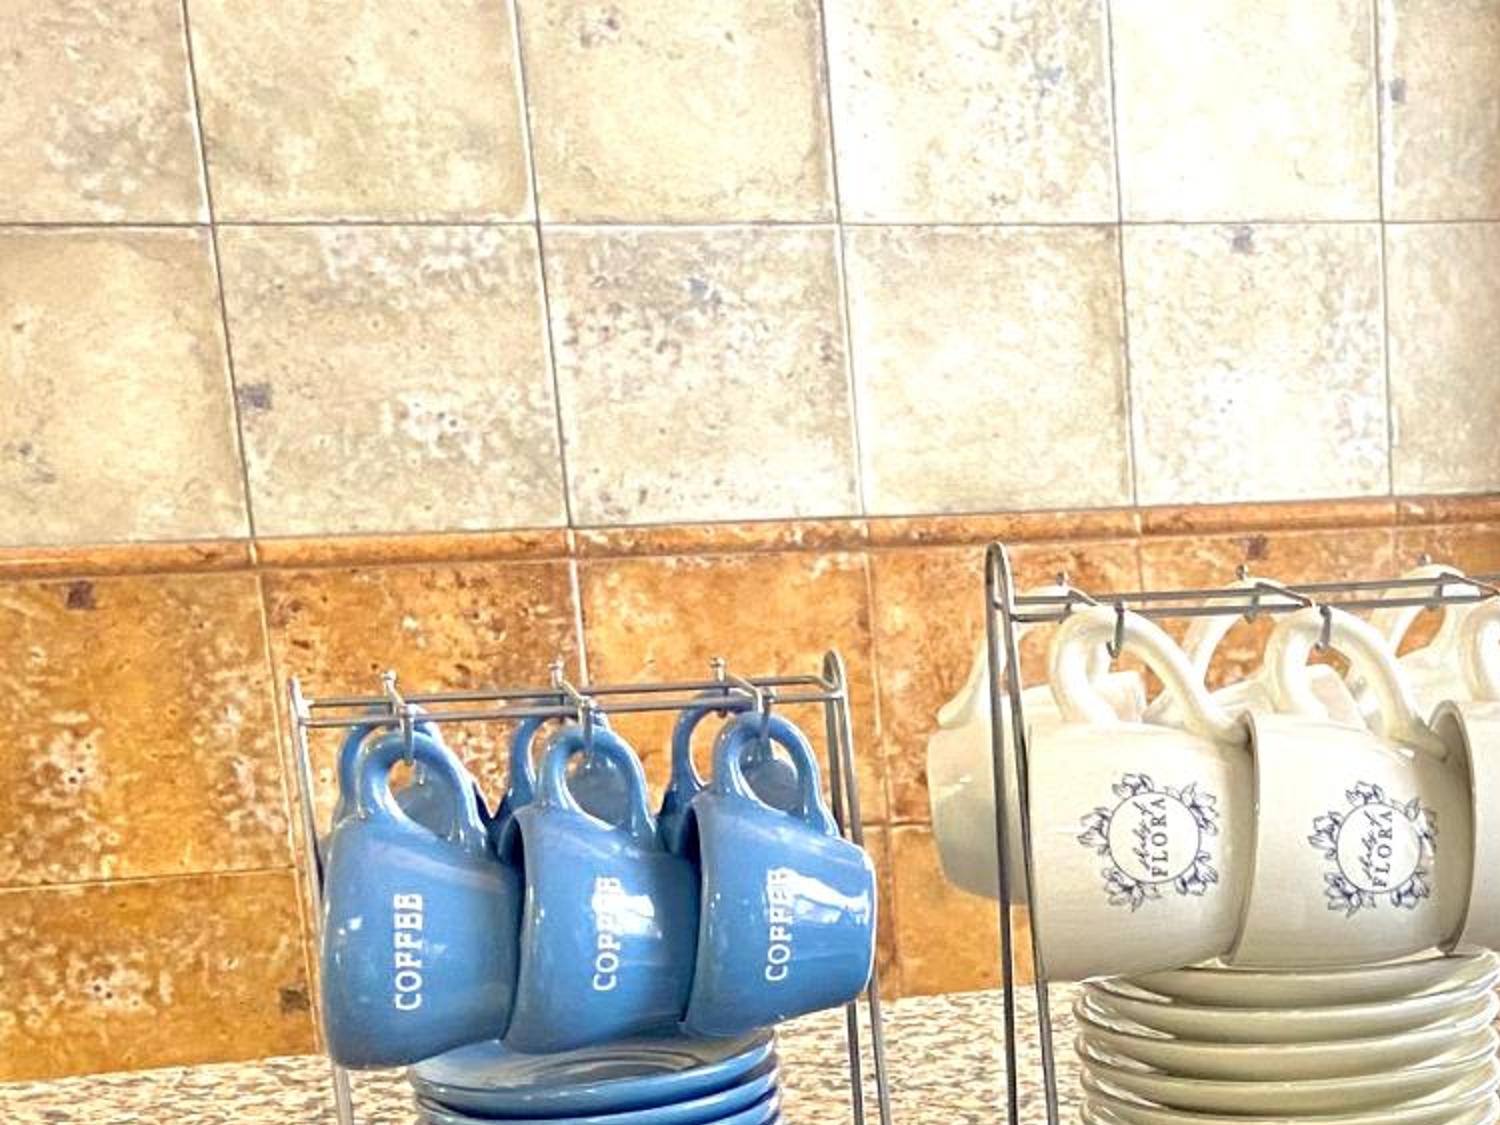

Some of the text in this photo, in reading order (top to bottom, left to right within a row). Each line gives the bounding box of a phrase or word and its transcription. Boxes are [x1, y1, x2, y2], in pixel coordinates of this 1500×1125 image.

[1149, 797, 1169, 878] FLORA
[1372, 810, 1393, 888] FLORA
[391, 892, 424, 1011] COFFEE
[764, 868, 797, 982] COFFEE
